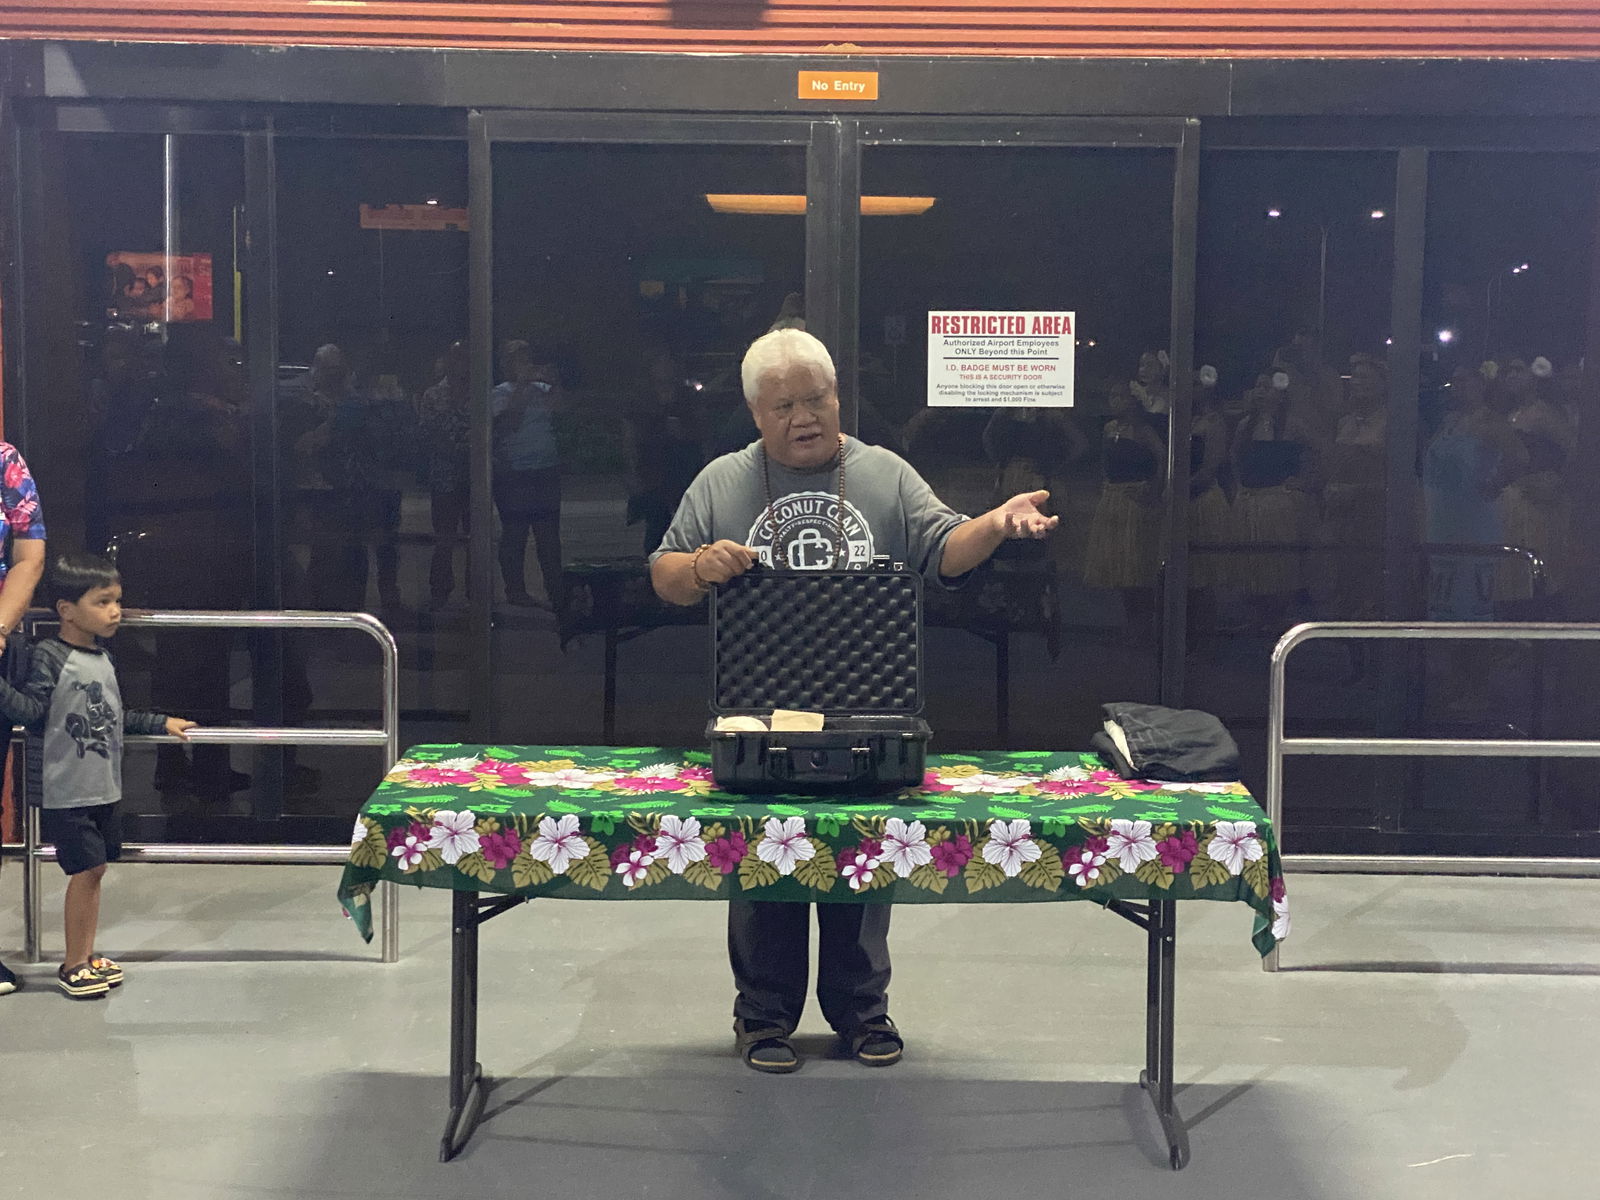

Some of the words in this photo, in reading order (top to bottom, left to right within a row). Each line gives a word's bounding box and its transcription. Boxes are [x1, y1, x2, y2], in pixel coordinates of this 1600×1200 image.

[811, 80, 829, 91] No
[834, 80, 865, 93] Entry
[931, 316, 1026, 334] RESTRICTED
[1032, 316, 1072, 335] AREA
[943, 339, 986, 347] Authorized
[987, 339, 1015, 348] Airport
[1017, 339, 1059, 348] Employees
[979, 348, 1009, 356] Beyond
[961, 364, 990, 372] BADGE
[992, 364, 1015, 372] MUST
[1017, 364, 1029, 372] BE
[1030, 364, 1056, 372] WORN
[759, 500, 824, 541] COCONUT
[854, 545, 866, 557] 22
